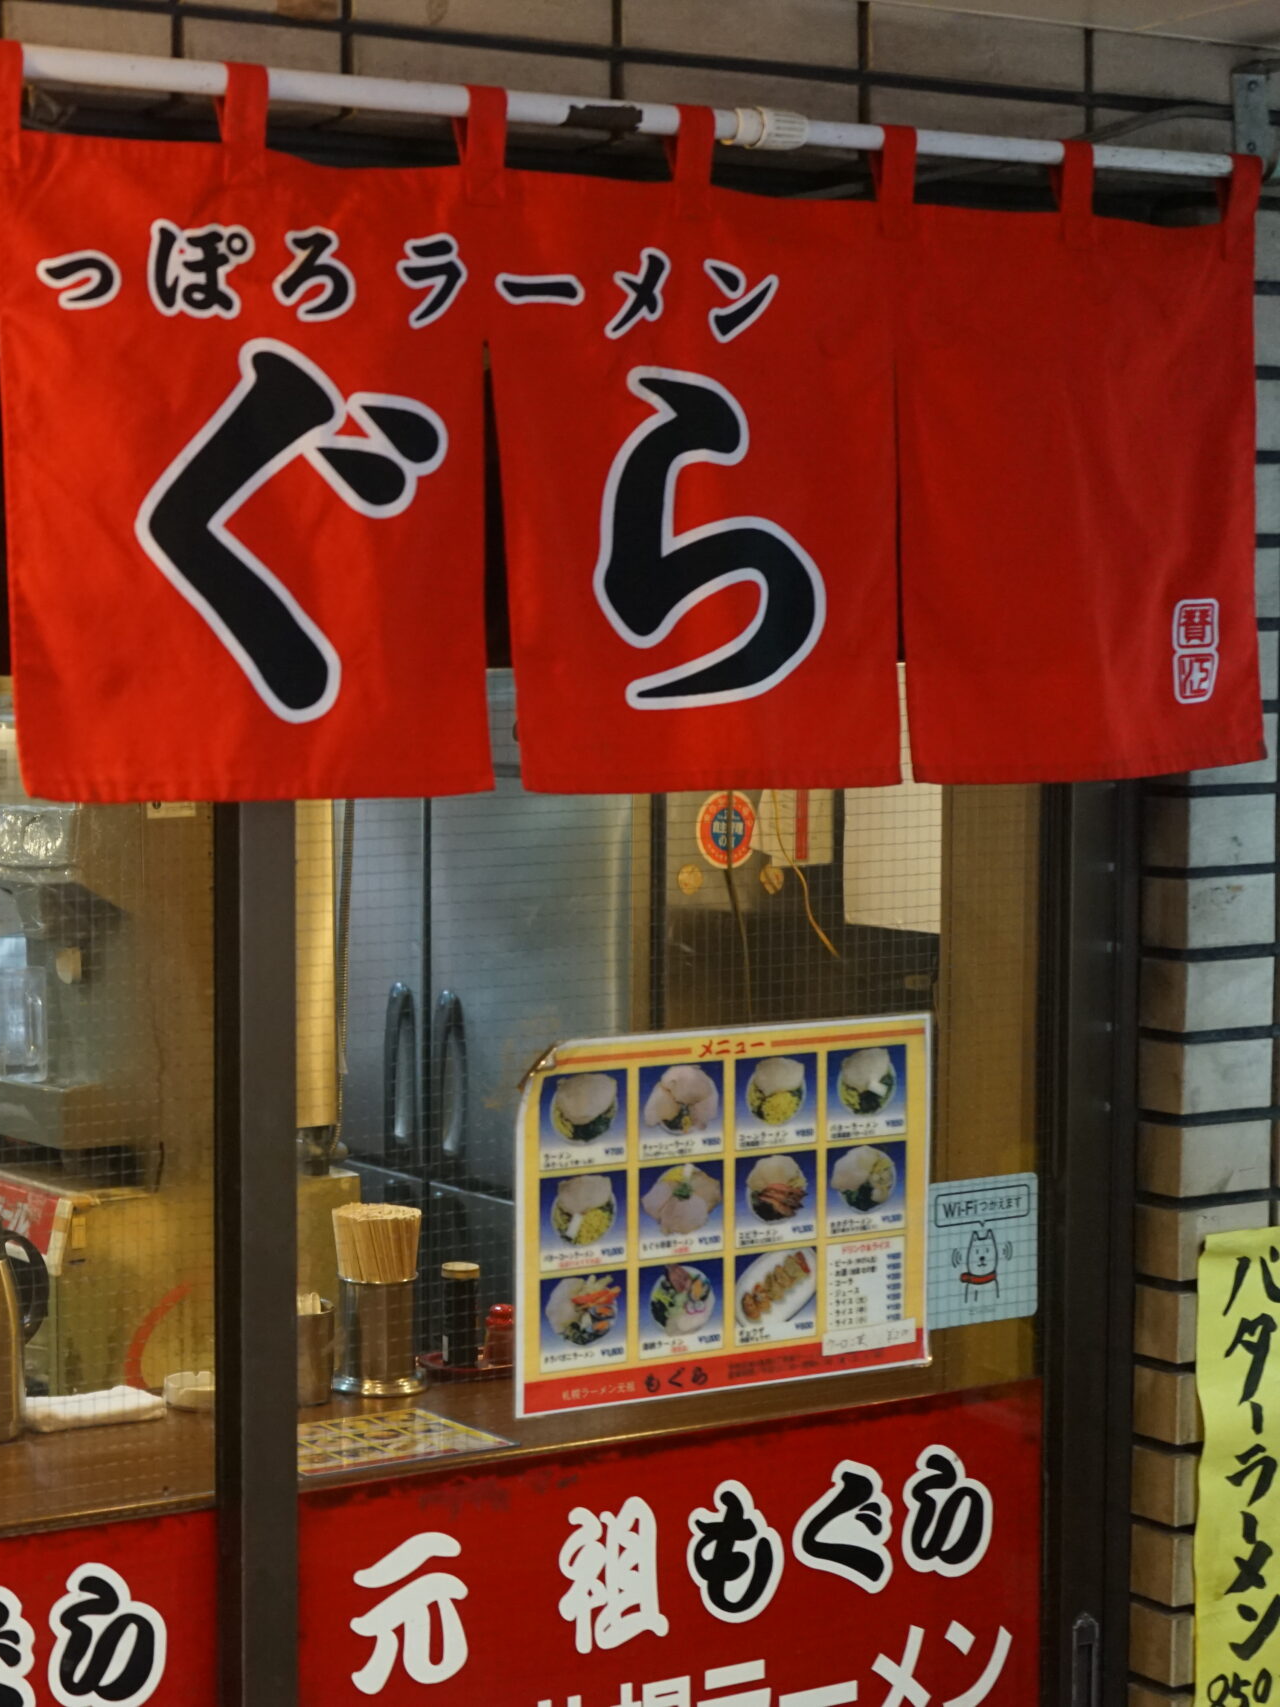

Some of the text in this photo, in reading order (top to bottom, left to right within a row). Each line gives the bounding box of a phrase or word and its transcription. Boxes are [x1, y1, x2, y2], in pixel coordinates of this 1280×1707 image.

[698, 1040, 766, 1058] メニュー
[942, 1196, 1022, 1218] Wi-Fiつかえます
